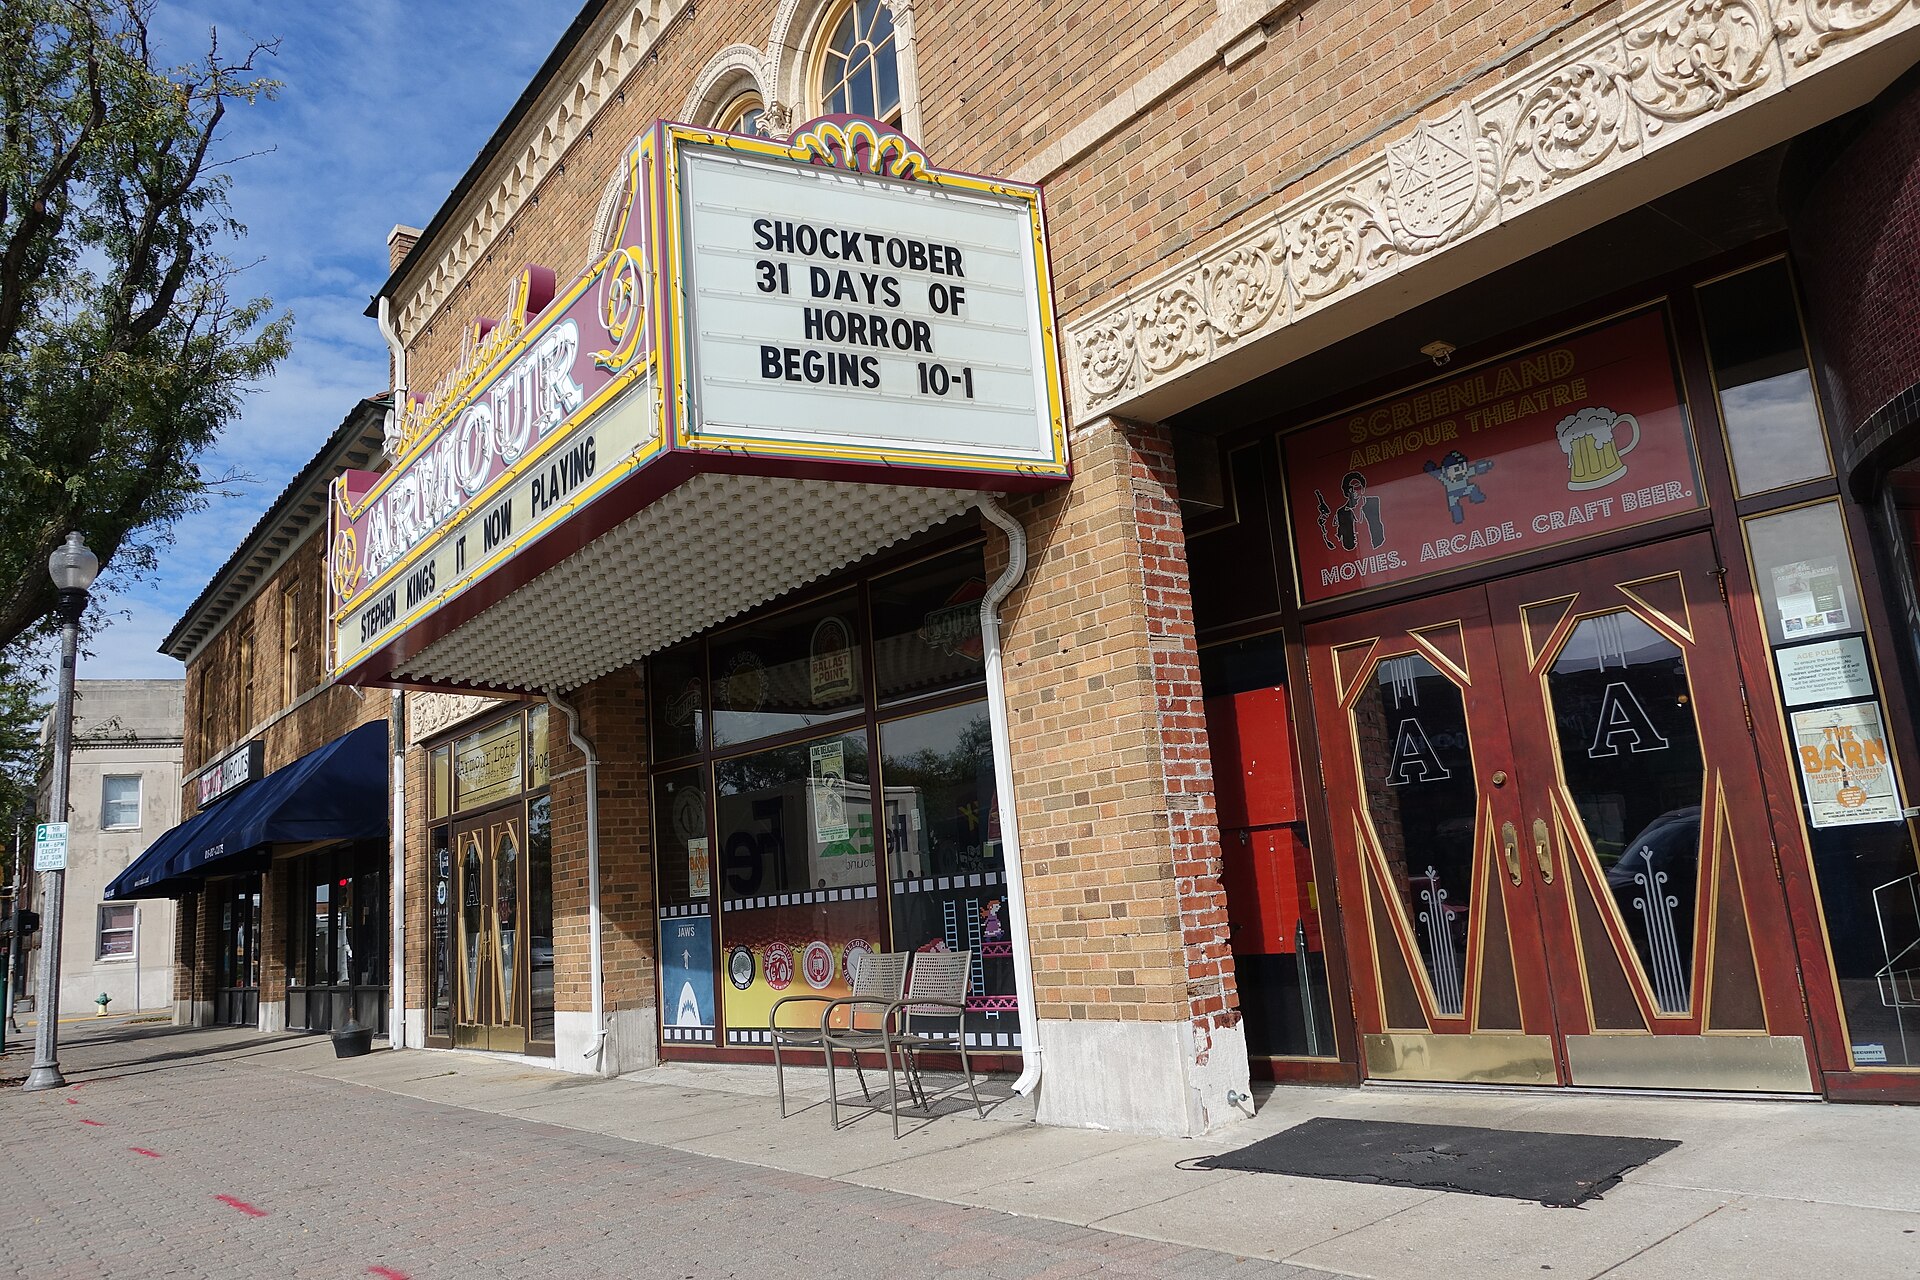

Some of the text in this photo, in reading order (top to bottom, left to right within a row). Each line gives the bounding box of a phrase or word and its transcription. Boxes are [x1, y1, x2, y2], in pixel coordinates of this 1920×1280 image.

[753, 218, 965, 278] SHOCKTOBER
[755, 260, 966, 316] 31 DAYS OF
[803, 307, 934, 354] HORROR
[760, 345, 975, 399] BEGINS 10-1
[1348, 348, 1576, 445] SCREENLAND
[1349, 377, 1589, 471] ARMOUR THEATRE
[362, 318, 584, 584] ARMOUR
[360, 435, 596, 644] STEPHEN KINGS IT NOW PLAYING
[1321, 480, 1693, 586] MOVIES. ARCADE. CRAFT BEER.
[812, 654, 849, 674] BALLAST
[1797, 647, 1845, 660] AGE POLICY
[818, 667, 845, 684] POINT
[1587, 681, 1670, 759] A
[1823, 725, 1854, 741] THE
[458, 740, 516, 776] Armour Loft
[534, 751, 549, 771] 406
[1385, 717, 1450, 787] A
[1799, 737, 1887, 773] BARN
[38, 827, 46, 840] 2
[38, 860, 63, 868] HOLIDAYS
[466, 873, 479, 907] A
[677, 926, 695, 938] JAWS
[771, 944, 793, 966] BELGIUM
